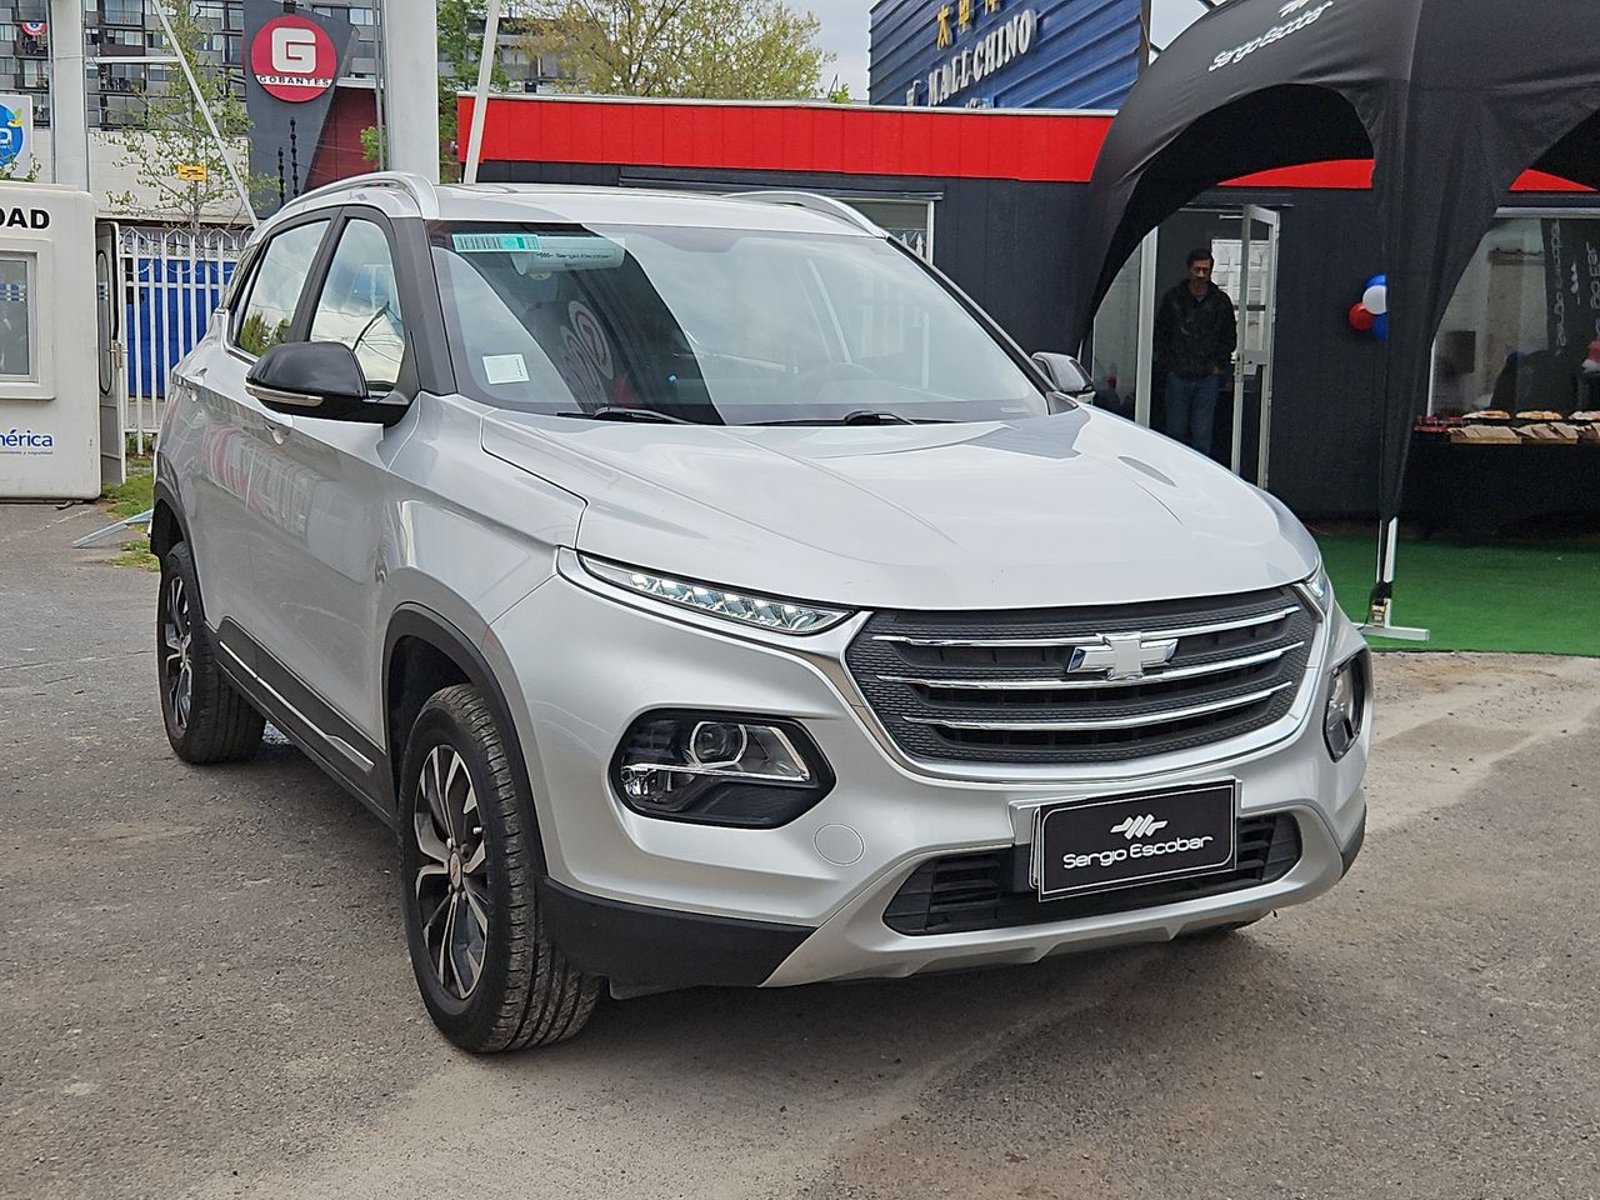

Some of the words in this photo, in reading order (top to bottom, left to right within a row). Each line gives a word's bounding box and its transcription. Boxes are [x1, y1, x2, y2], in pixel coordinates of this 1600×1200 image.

[1259, 0, 1334, 47] Escobar
[271, 27, 317, 74] G
[973, 9, 1034, 82] CHINO
[259, 75, 329, 87] GOBANTES
[0, 207, 51, 230] AD
[1129, 835, 1215, 858] Escobar
